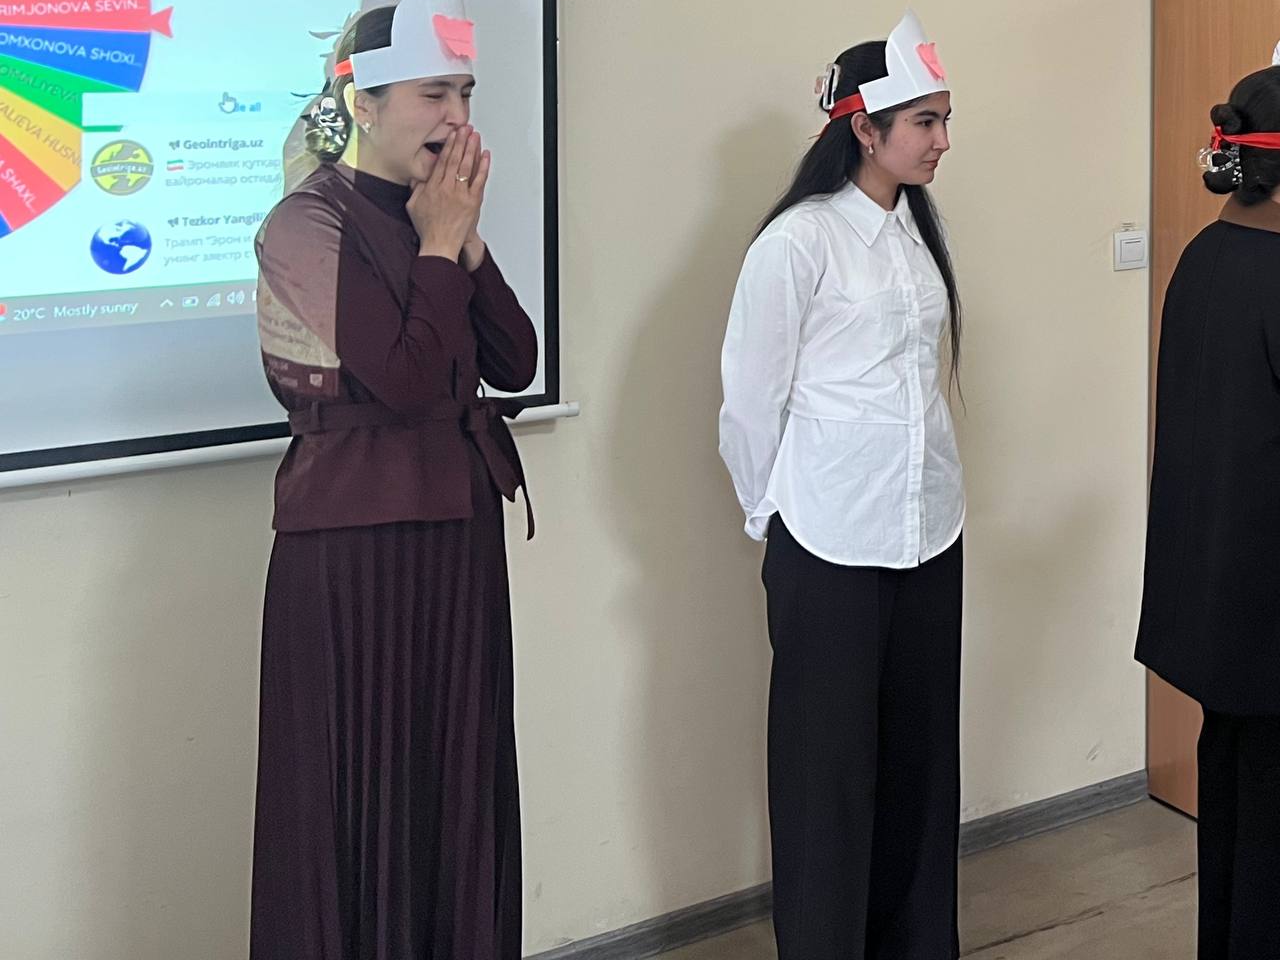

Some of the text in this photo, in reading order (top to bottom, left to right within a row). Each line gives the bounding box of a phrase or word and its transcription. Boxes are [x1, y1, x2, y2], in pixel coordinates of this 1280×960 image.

[182, 216, 221, 226] Tezkor
[53, 303, 98, 319] Mostly
[100, 301, 139, 315] sunny
